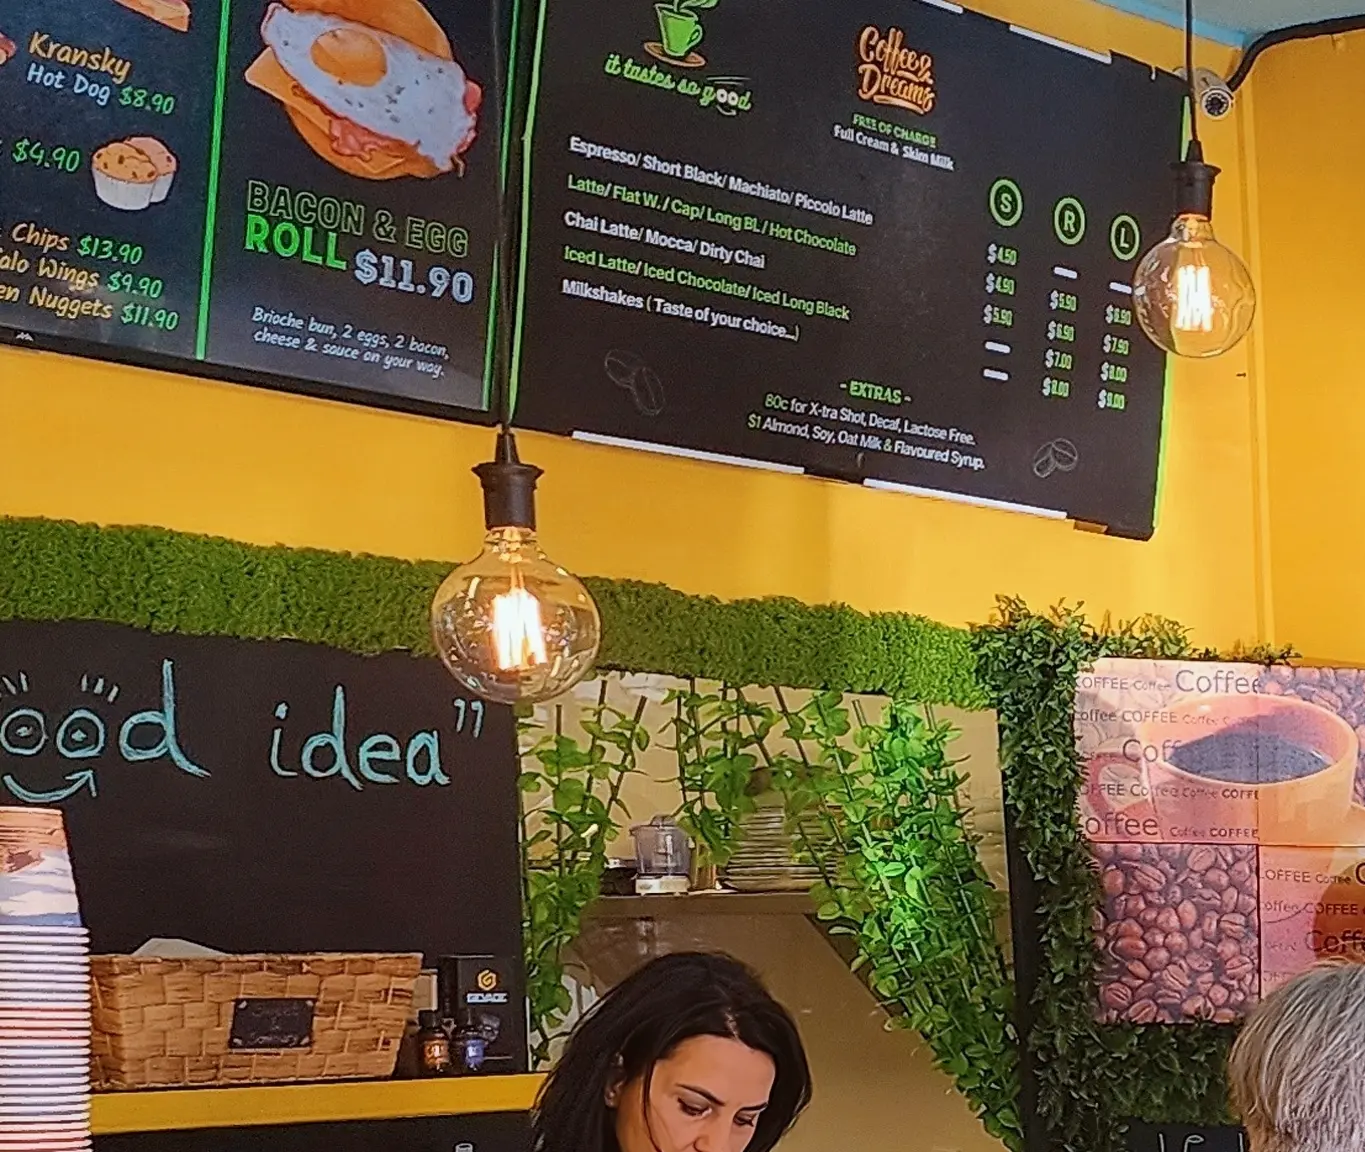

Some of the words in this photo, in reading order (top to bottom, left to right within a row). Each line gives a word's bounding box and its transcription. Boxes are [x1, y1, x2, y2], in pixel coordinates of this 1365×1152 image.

[29, 32, 133, 84] Kransky
[859, 25, 920, 74] Coffee
[27, 63, 63, 88] Hot
[74, 73, 110, 106] Dog
[119, 86, 175, 115] $8.90
[605, 55, 621, 75] it
[623, 58, 676, 89] tastes
[677, 81, 699, 96] so
[699, 84, 751, 111] good
[858, 64, 936, 111] Dreams
[833, 125, 854, 143] Full
[855, 131, 889, 153] Cream
[890, 141, 899, 155] &
[902, 145, 928, 163] Skim
[853, 114, 877, 131] FREE
[894, 123, 937, 148] CHARGE
[12, 139, 80, 172] $4.90
[570, 136, 641, 166] Espresso/
[643, 154, 681, 176] Short
[684, 165, 727, 188] Black/
[795, 193, 840, 217] Piccolo
[842, 205, 873, 225] Latte
[1000, 193, 1011, 213] S
[247, 180, 364, 235] BACON
[373, 210, 397, 243] &
[406, 217, 468, 257] EGG
[568, 174, 612, 197] Latte/
[613, 185, 640, 204] Flat
[671, 200, 705, 220] Cap/
[707, 207, 742, 231] Long
[770, 223, 793, 241] Hot
[794, 229, 856, 256] Chocolate
[1064, 211, 1075, 233] R
[1120, 227, 1129, 249] L
[12, 223, 70, 253] Chips
[77, 235, 142, 264] $13.90
[245, 214, 347, 271] ROLL
[354, 249, 473, 302] $11.90
[565, 211, 598, 231] Chai
[601, 219, 644, 241] Latte/
[646, 229, 698, 253] Mocca/
[700, 241, 733, 264] Dirty
[735, 250, 765, 269] Chai
[38, 257, 99, 291] Wings
[107, 271, 162, 298] $9.90
[564, 246, 596, 265] Iced
[599, 254, 642, 274] Latte/
[644, 264, 674, 282] Iced
[677, 271, 751, 298] Chocolate/
[753, 287, 780, 304] Iced
[783, 292, 814, 316] Long
[817, 301, 850, 320] Black
[29, 286, 112, 319] Nuggets
[121, 302, 179, 330] $11.90
[562, 279, 644, 308] Milkshakes
[695, 308, 709, 321] of
[711, 311, 742, 328] your
[252, 307, 303, 329] Brioche
[308, 317, 337, 339] bun,
[342, 325, 352, 339] 2
[357, 328, 389, 348] eggs,
[394, 335, 405, 347] 2
[409, 340, 449, 360] bacon,
[254, 327, 300, 348] cheese
[305, 339, 318, 351] &
[323, 343, 359, 360] sauce
[363, 350, 380, 363] on
[384, 353, 411, 369] your
[416, 361, 445, 378] way.
[762, 417, 810, 438] Almond,
[838, 431, 858, 446] Oat
[859, 434, 882, 450] Milk
[884, 438, 892, 451] &
[894, 440, 948, 462] Flavoured
[790, 399, 806, 413] for
[810, 402, 838, 419] X-tra
[840, 407, 866, 426] Shot,
[869, 413, 901, 433] Decaf,
[904, 420, 947, 440] Lactose
[1122, 711, 1178, 723] COFFEE
[1305, 903, 1358, 915] COFFEE
